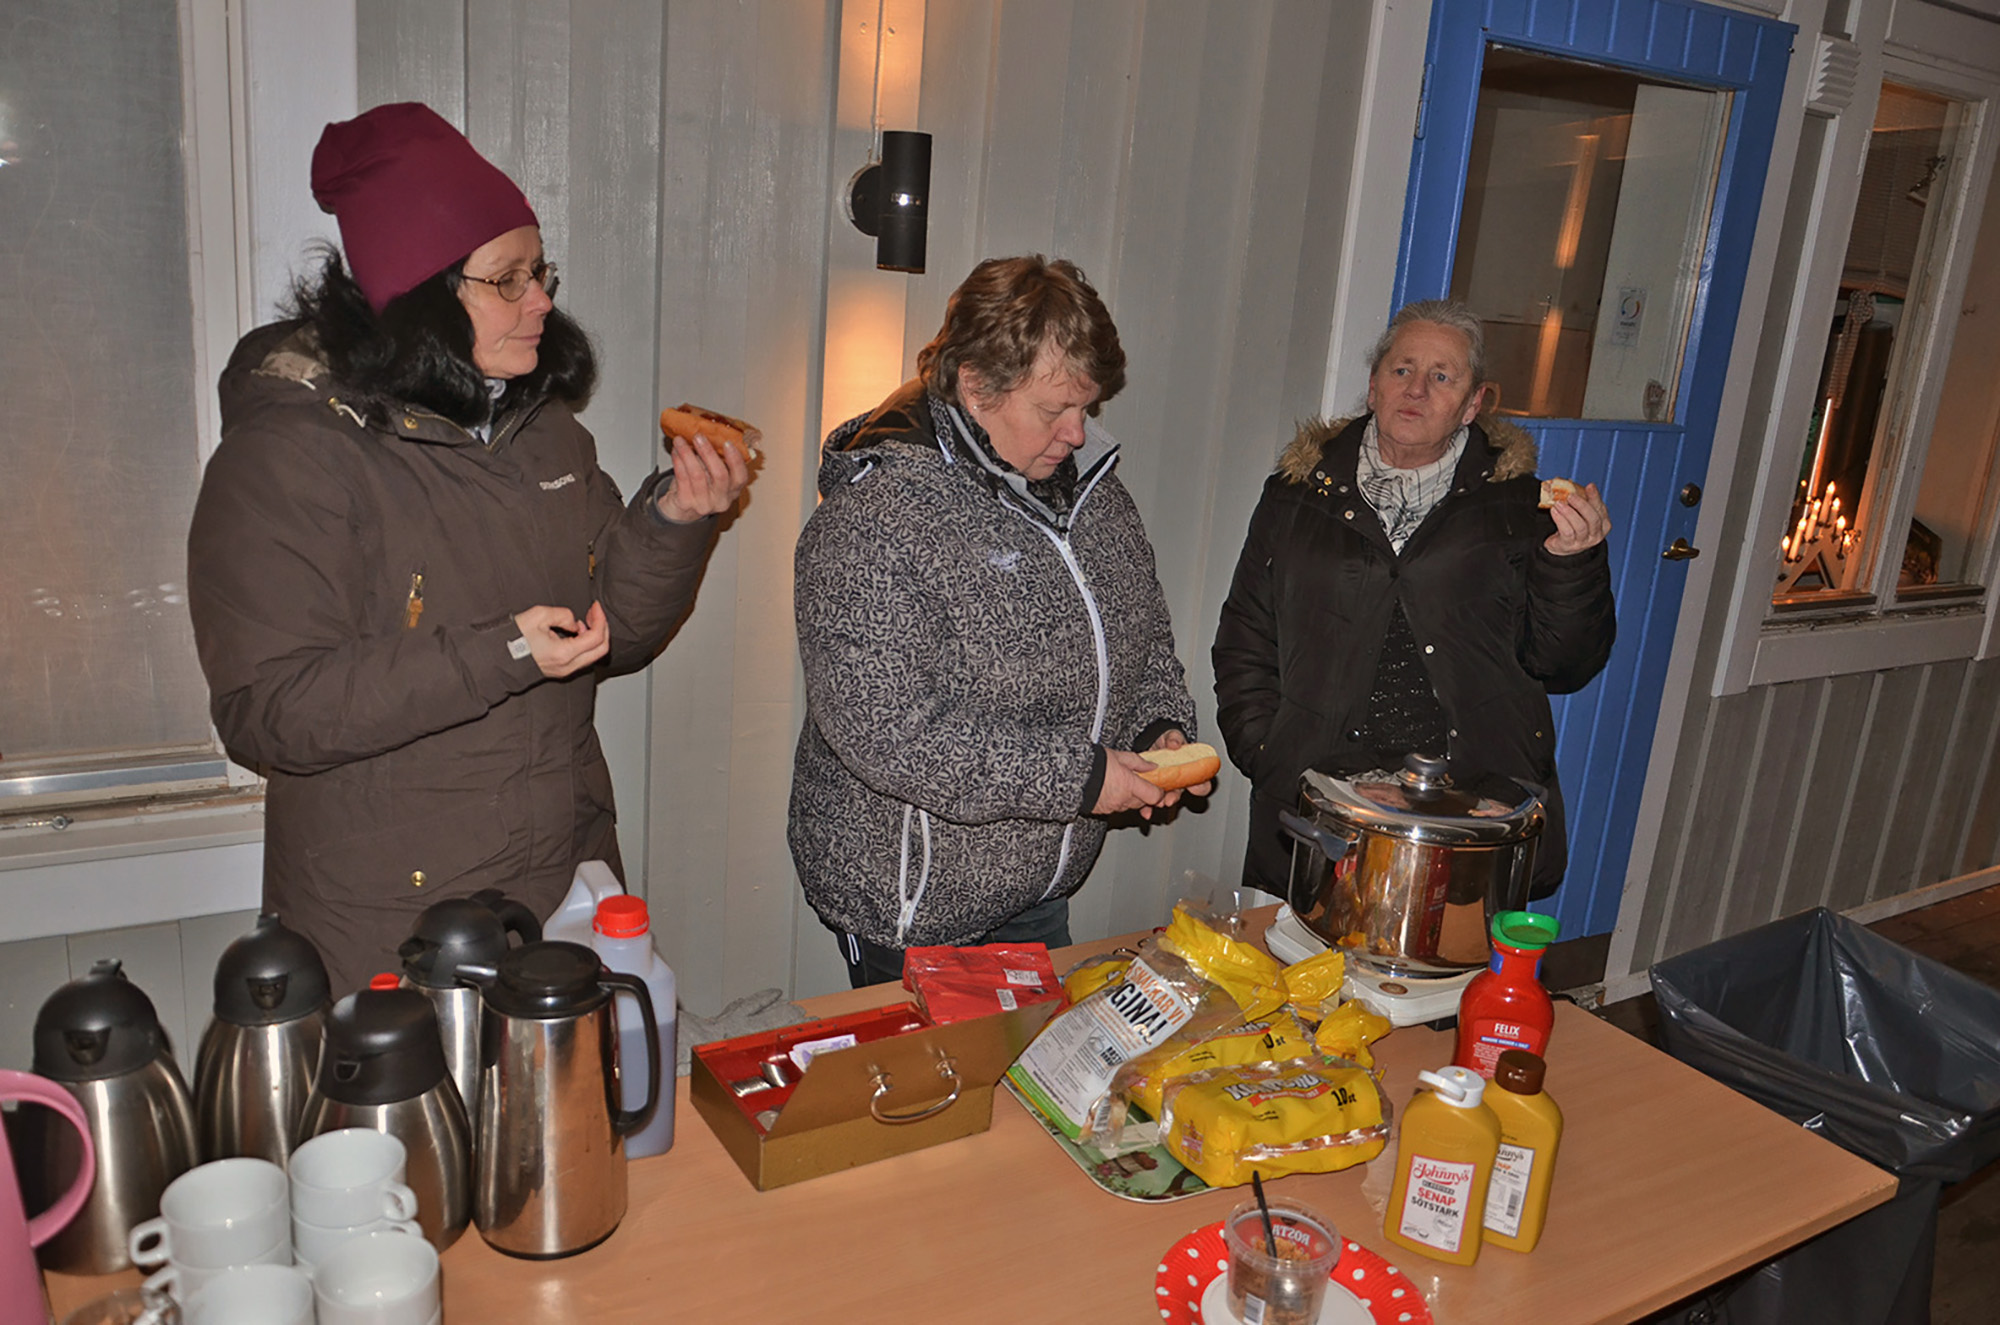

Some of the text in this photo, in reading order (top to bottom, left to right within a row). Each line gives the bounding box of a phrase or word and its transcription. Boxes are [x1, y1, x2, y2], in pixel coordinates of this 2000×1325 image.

[1110, 980, 1168, 1045] GINAL
[1167, 1006, 1186, 1025] VI
[1494, 1022, 1521, 1036] FELIX
[1413, 1163, 1470, 1185] Johnny's
[1417, 1187, 1457, 1206] SENAP
[1411, 1196, 1460, 1218] SÖTSTARK
